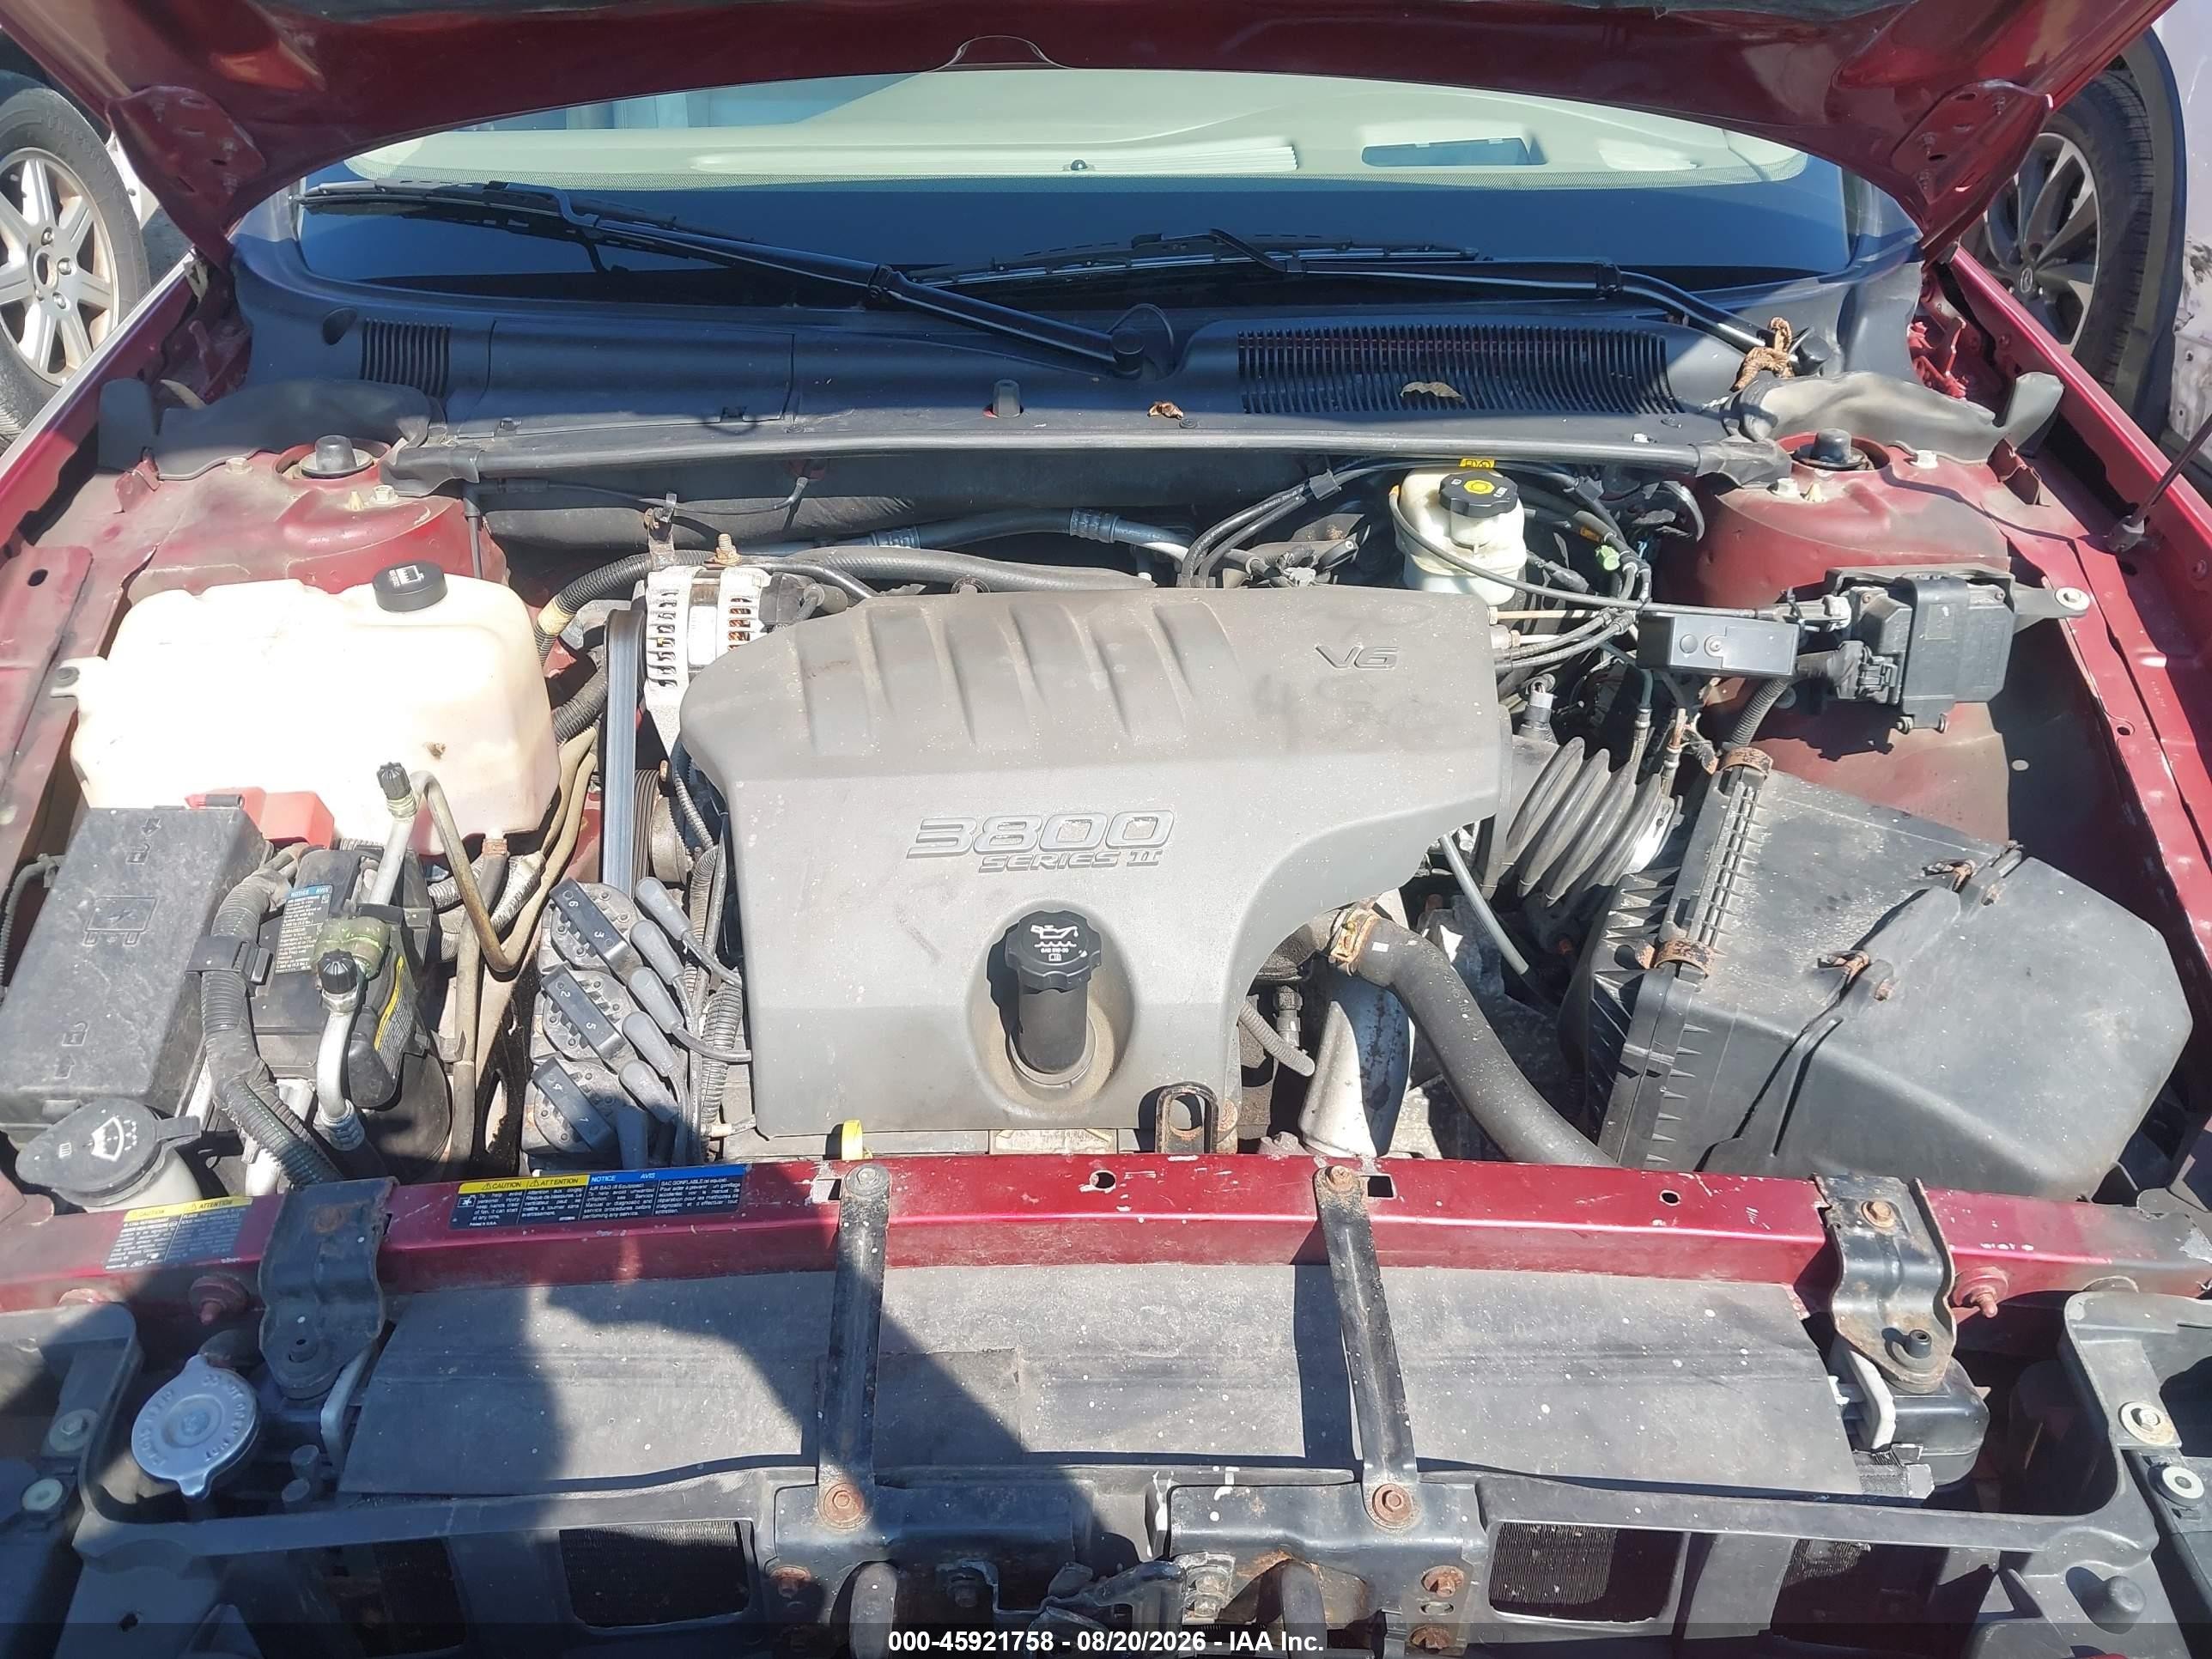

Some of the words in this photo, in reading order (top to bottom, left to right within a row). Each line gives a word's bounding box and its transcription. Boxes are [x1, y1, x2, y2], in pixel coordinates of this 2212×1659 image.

[1315, 645, 1398, 670] V6
[906, 810, 1174, 859] 3800
[978, 851, 1121, 873] SERIES
[1127, 848, 1163, 866] II
[594, 930, 605, 939] 3
[560, 990, 570, 999] 2
[552, 1083, 562, 1091] 4
[199, 1200, 233, 1210] ATTENTION
